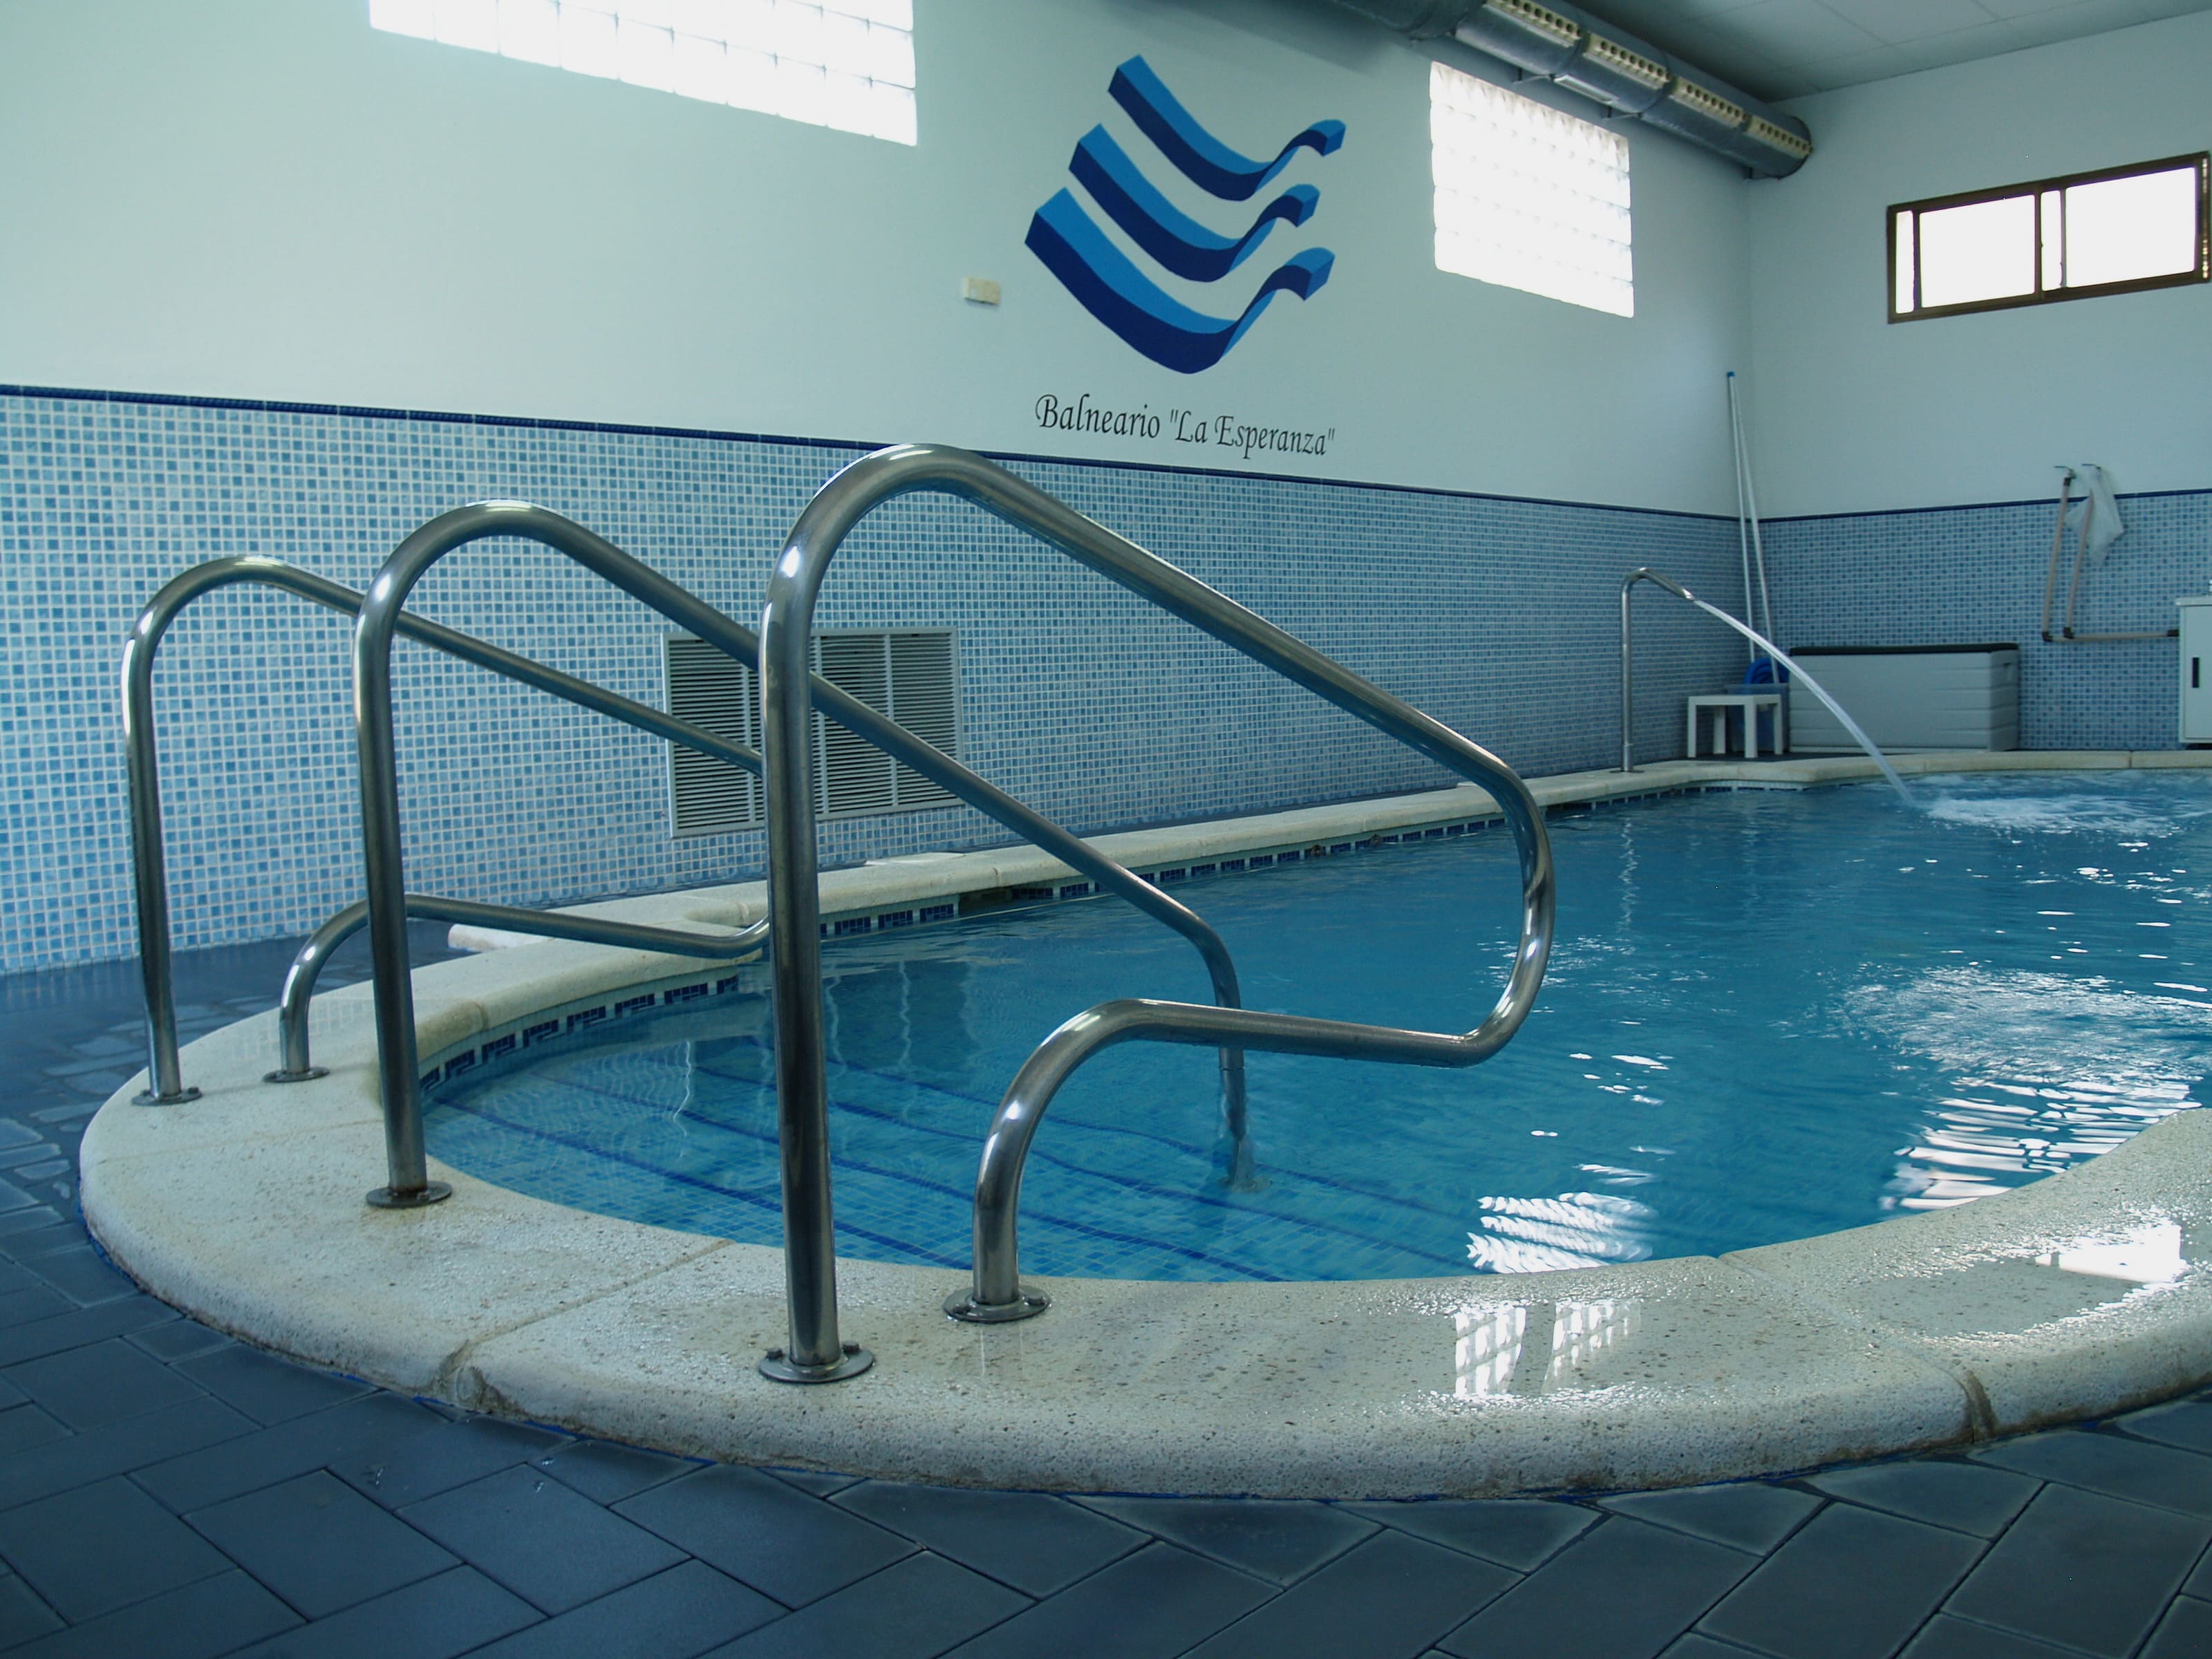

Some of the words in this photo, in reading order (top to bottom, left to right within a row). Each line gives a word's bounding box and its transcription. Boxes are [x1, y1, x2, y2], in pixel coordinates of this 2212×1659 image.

[1035, 393, 1160, 438] Balneario
[1170, 409, 1208, 443] "La
[1215, 415, 1335, 459] Esperanza"
